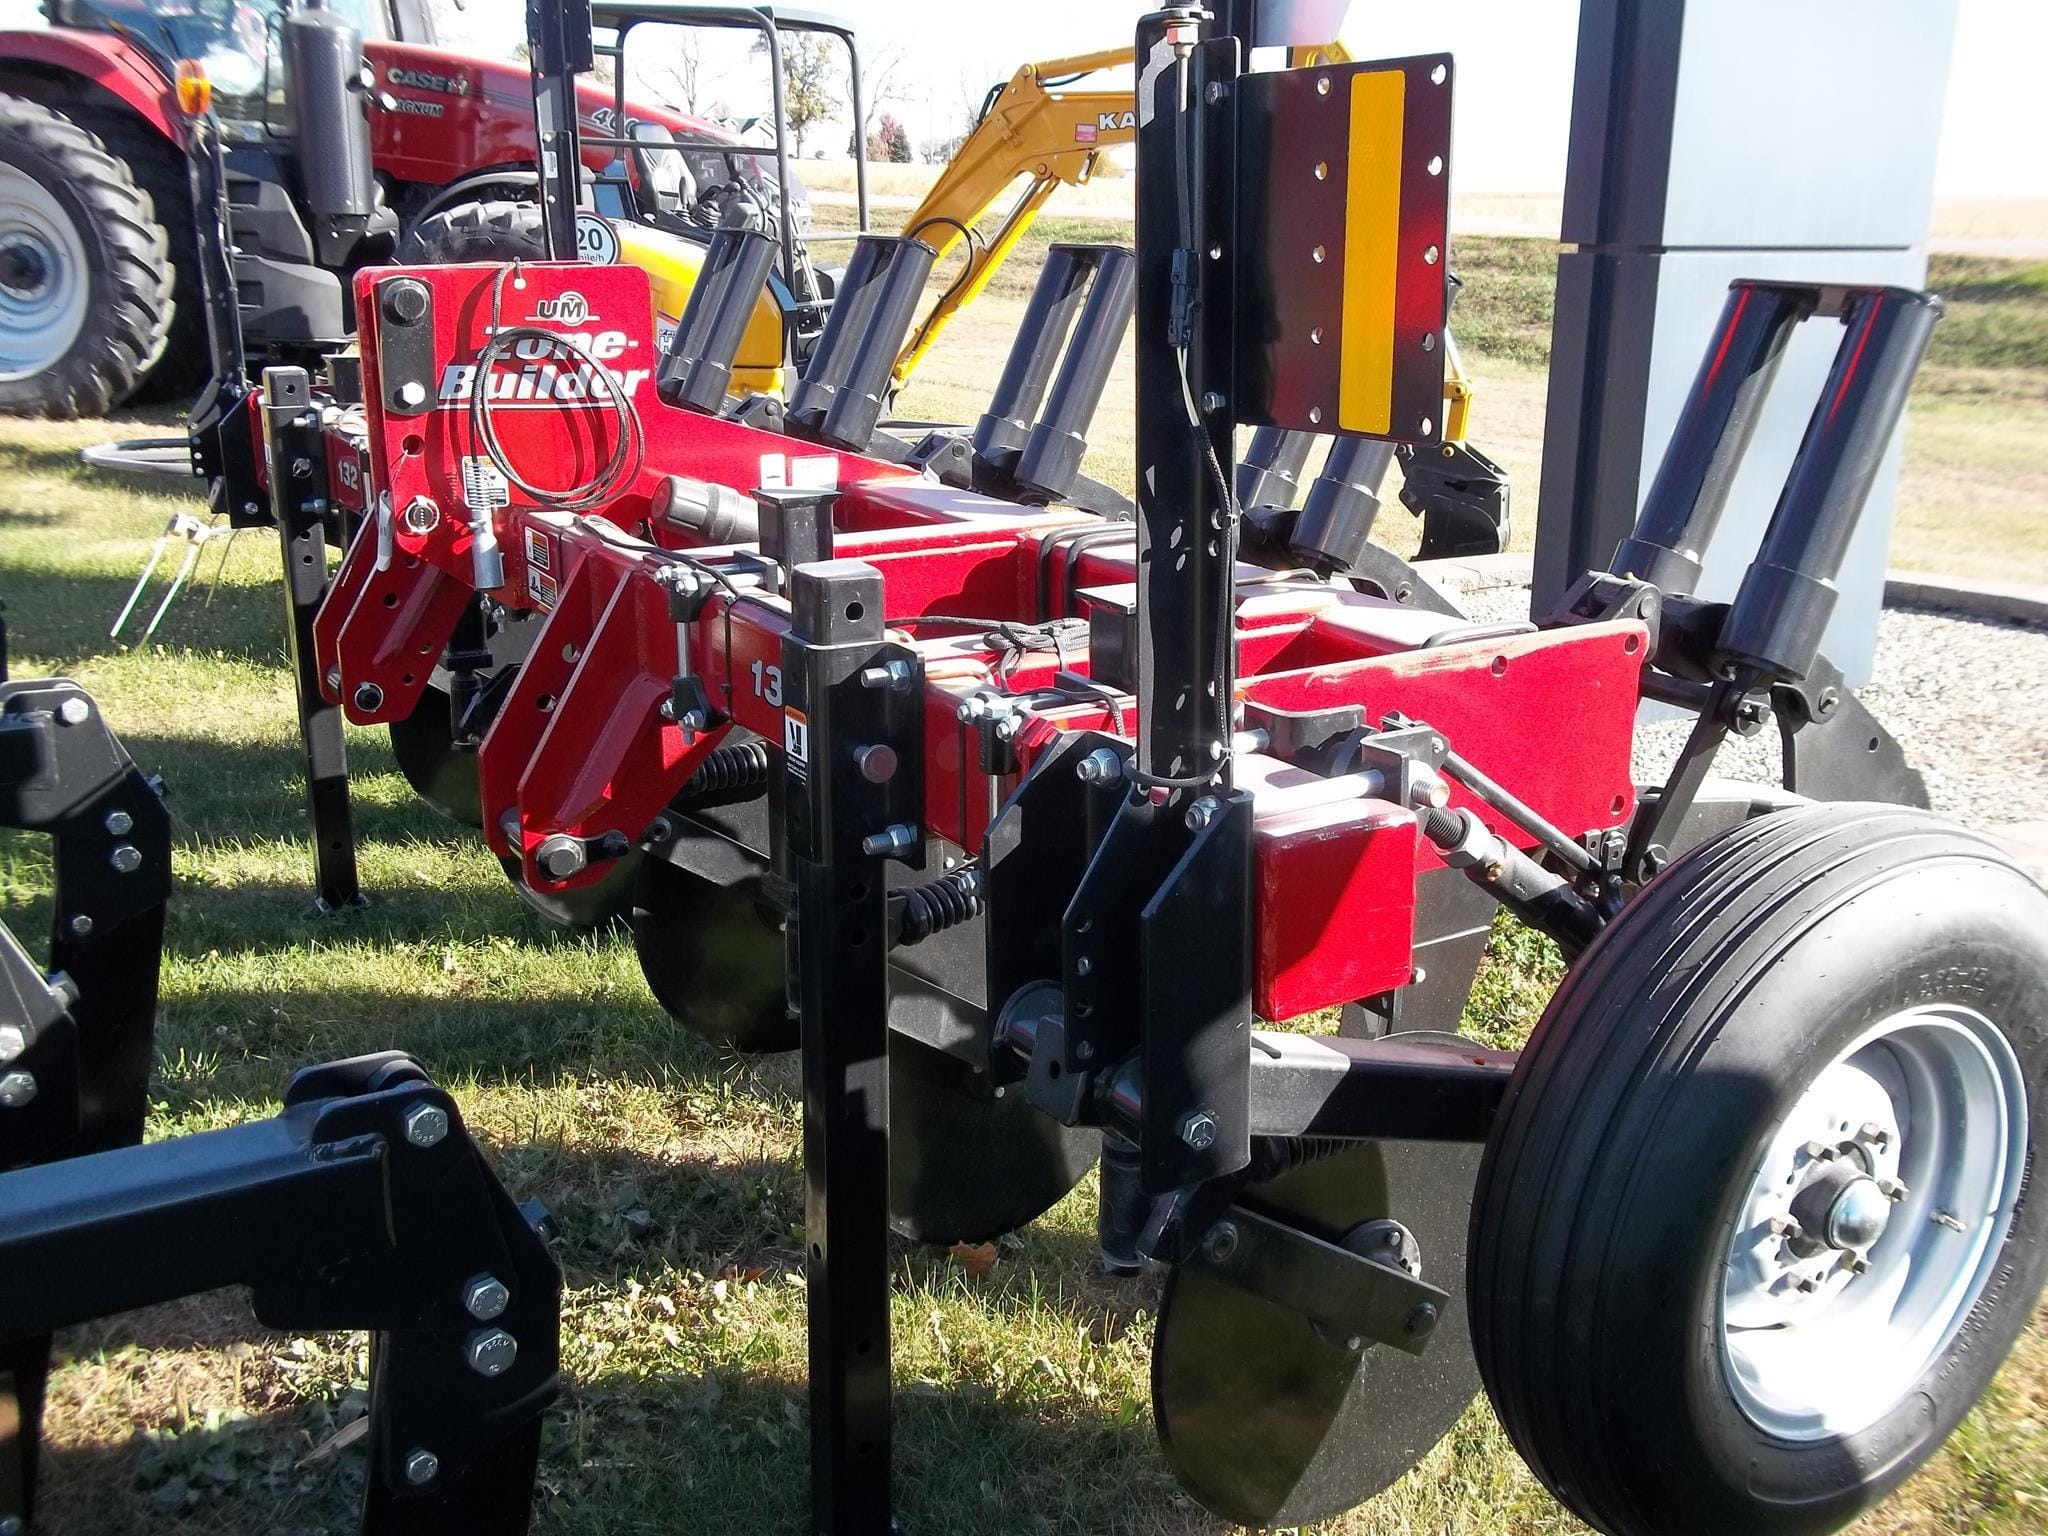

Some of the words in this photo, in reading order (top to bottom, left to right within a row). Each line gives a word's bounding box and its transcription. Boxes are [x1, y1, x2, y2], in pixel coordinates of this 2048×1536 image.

[387, 67, 446, 92] CASE
[396, 98, 444, 118] AGNUM
[577, 228, 603, 251] 20
[438, 365, 650, 400] Builder
[338, 460, 358, 490] 132
